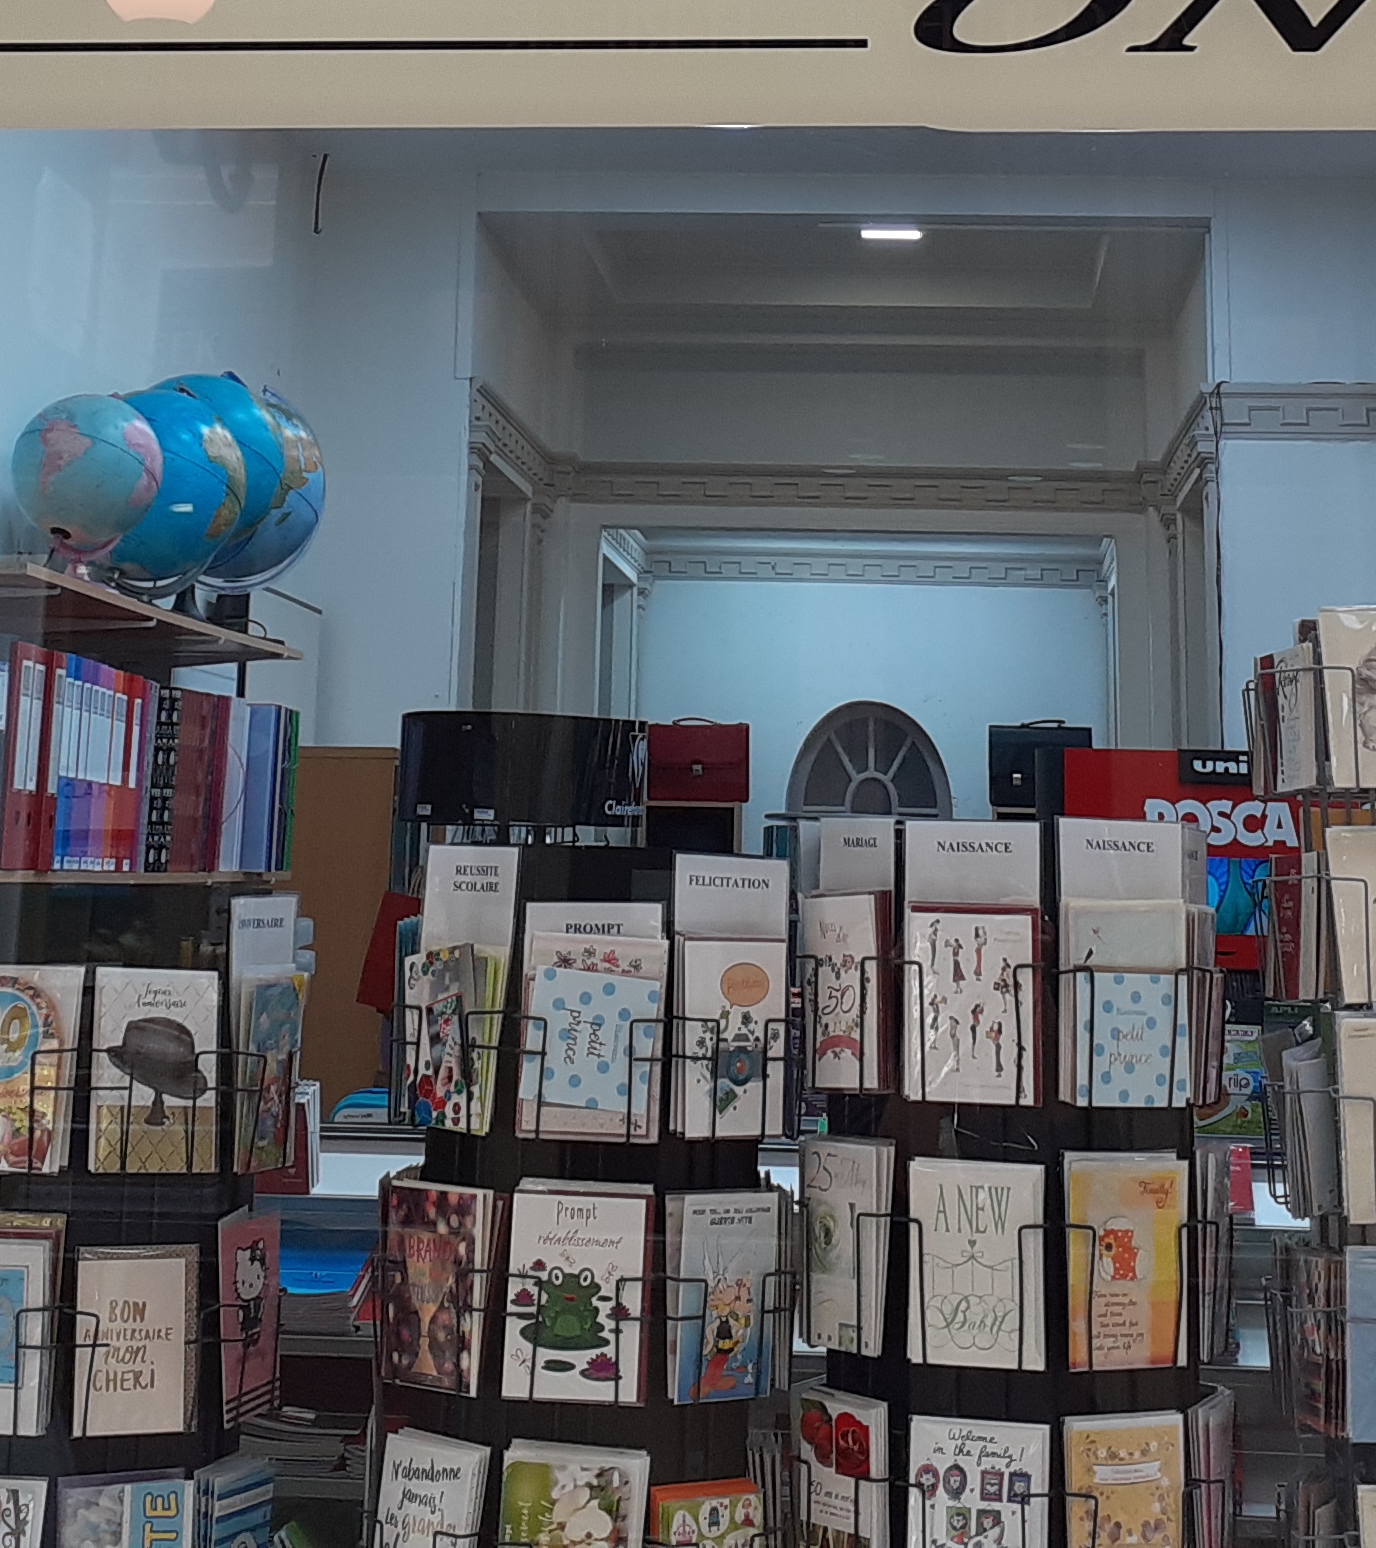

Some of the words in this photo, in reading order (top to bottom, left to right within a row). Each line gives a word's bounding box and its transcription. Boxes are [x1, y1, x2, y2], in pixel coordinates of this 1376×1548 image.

[1192, 755, 1249, 774] uni
[842, 836, 878, 849] MARIAGE
[936, 840, 1013, 854] NAISSANCE
[1085, 837, 1155, 854] NAISSANCE
[455, 864, 500, 878] REUSSITE
[452, 880, 500, 893] SCOLAIRE
[688, 873, 771, 890] FELICITATION
[565, 922, 624, 935] PROMPT
[821, 984, 856, 1016] 50
[562, 1007, 582, 1066] prince
[556, 1200, 598, 1227] Prompt
[933, 1183, 950, 1233] A
[957, 1184, 1011, 1236] NEW
[108, 1299, 147, 1324] BON
[84, 1326, 174, 1343] ANIVERSAIRE
[104, 1344, 147, 1366] mon
[948, 1428, 998, 1445] Welcome
[953, 1442, 973, 1457] the
[391, 1457, 462, 1483] N'abandonne
